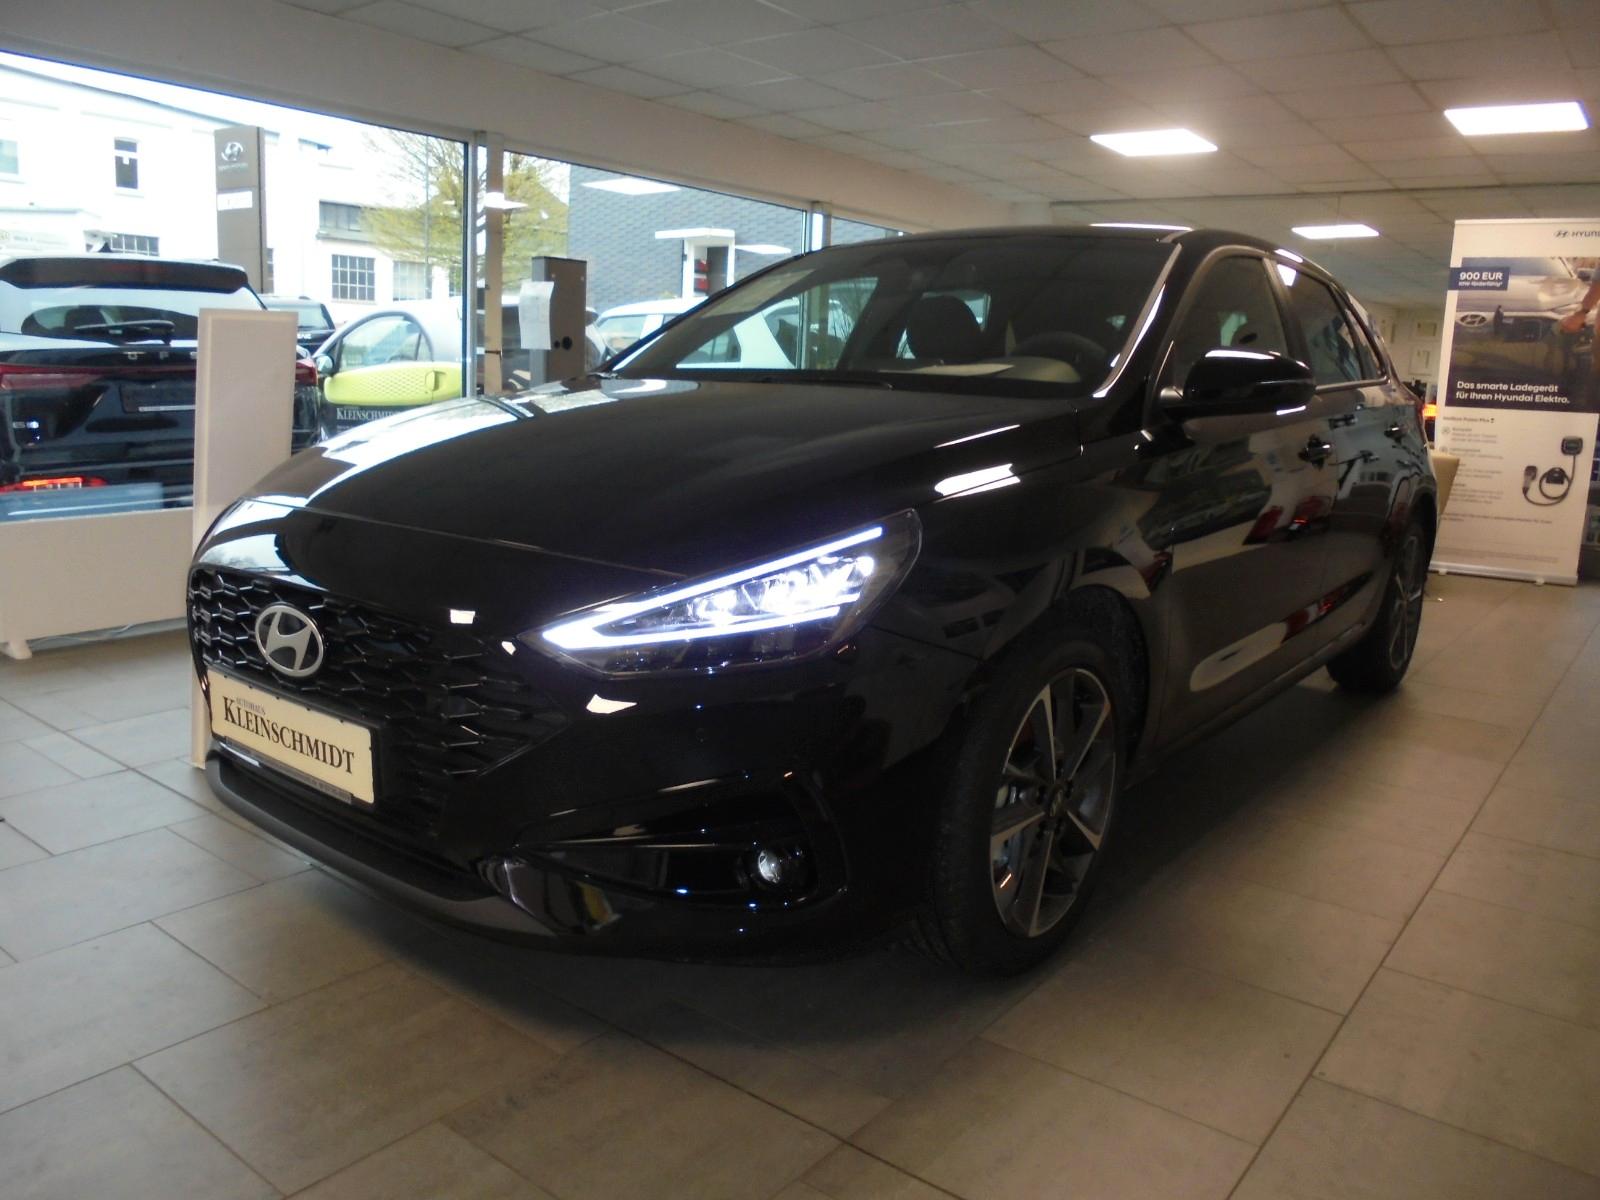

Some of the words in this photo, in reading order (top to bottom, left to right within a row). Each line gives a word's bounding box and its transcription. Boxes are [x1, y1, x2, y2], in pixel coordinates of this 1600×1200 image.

[1459, 271, 1480, 280] 900
[1482, 271, 1504, 280] EUR
[1457, 381, 1475, 389] Das
[1476, 382, 1509, 391] smarte
[1510, 383, 1559, 393] Ladegerät
[1455, 391, 1470, 399] für
[1470, 391, 1493, 400] Ihren
[1494, 393, 1533, 402] Hyundai
[1534, 394, 1571, 404] Elektro.
[222, 696, 355, 774] KLEINSCHMIDT
